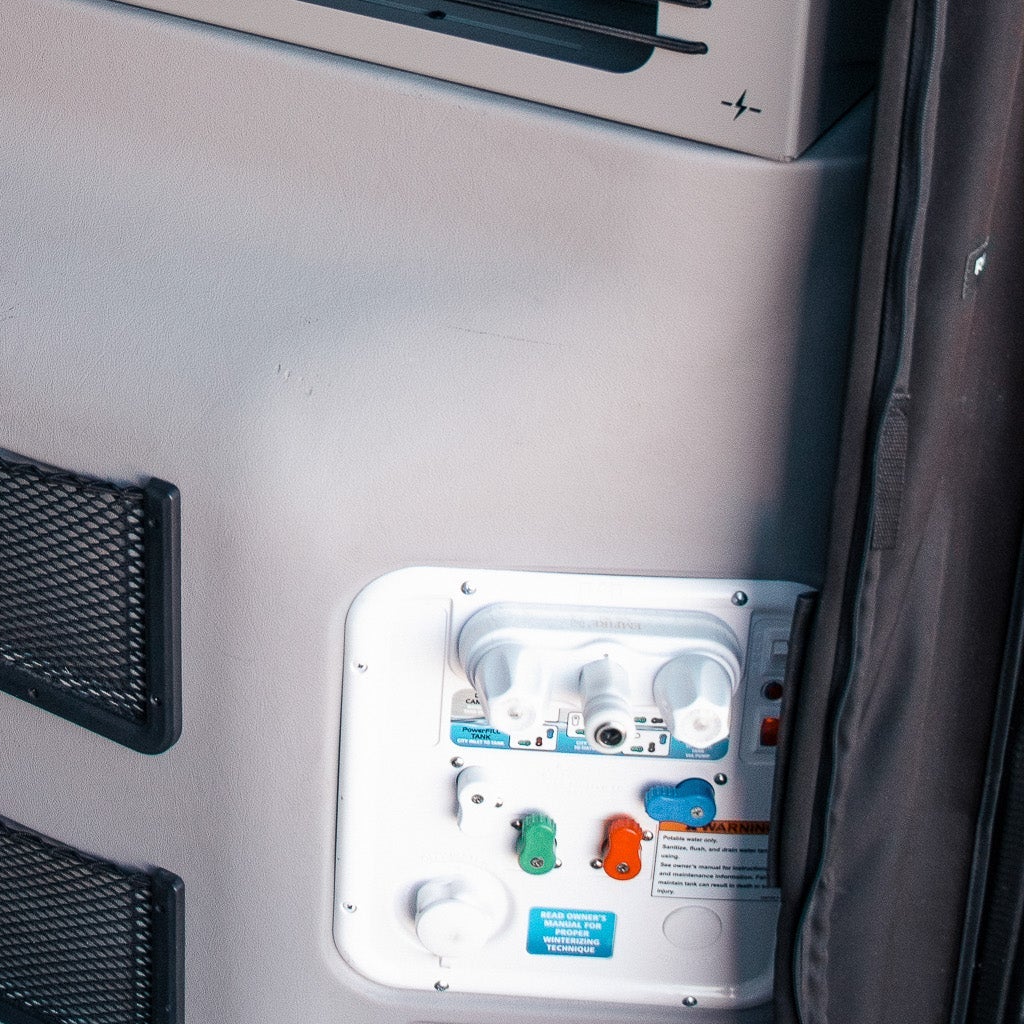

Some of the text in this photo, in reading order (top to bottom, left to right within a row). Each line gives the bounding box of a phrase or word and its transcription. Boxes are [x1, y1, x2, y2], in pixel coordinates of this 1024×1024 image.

[541, 911, 607, 921] READ OWNER'S
[544, 920, 582, 928] MANUAL
[555, 929, 590, 937] PROPER
[543, 936, 600, 946] WINTERIZING
[547, 945, 595, 953] TECHNIQUE
